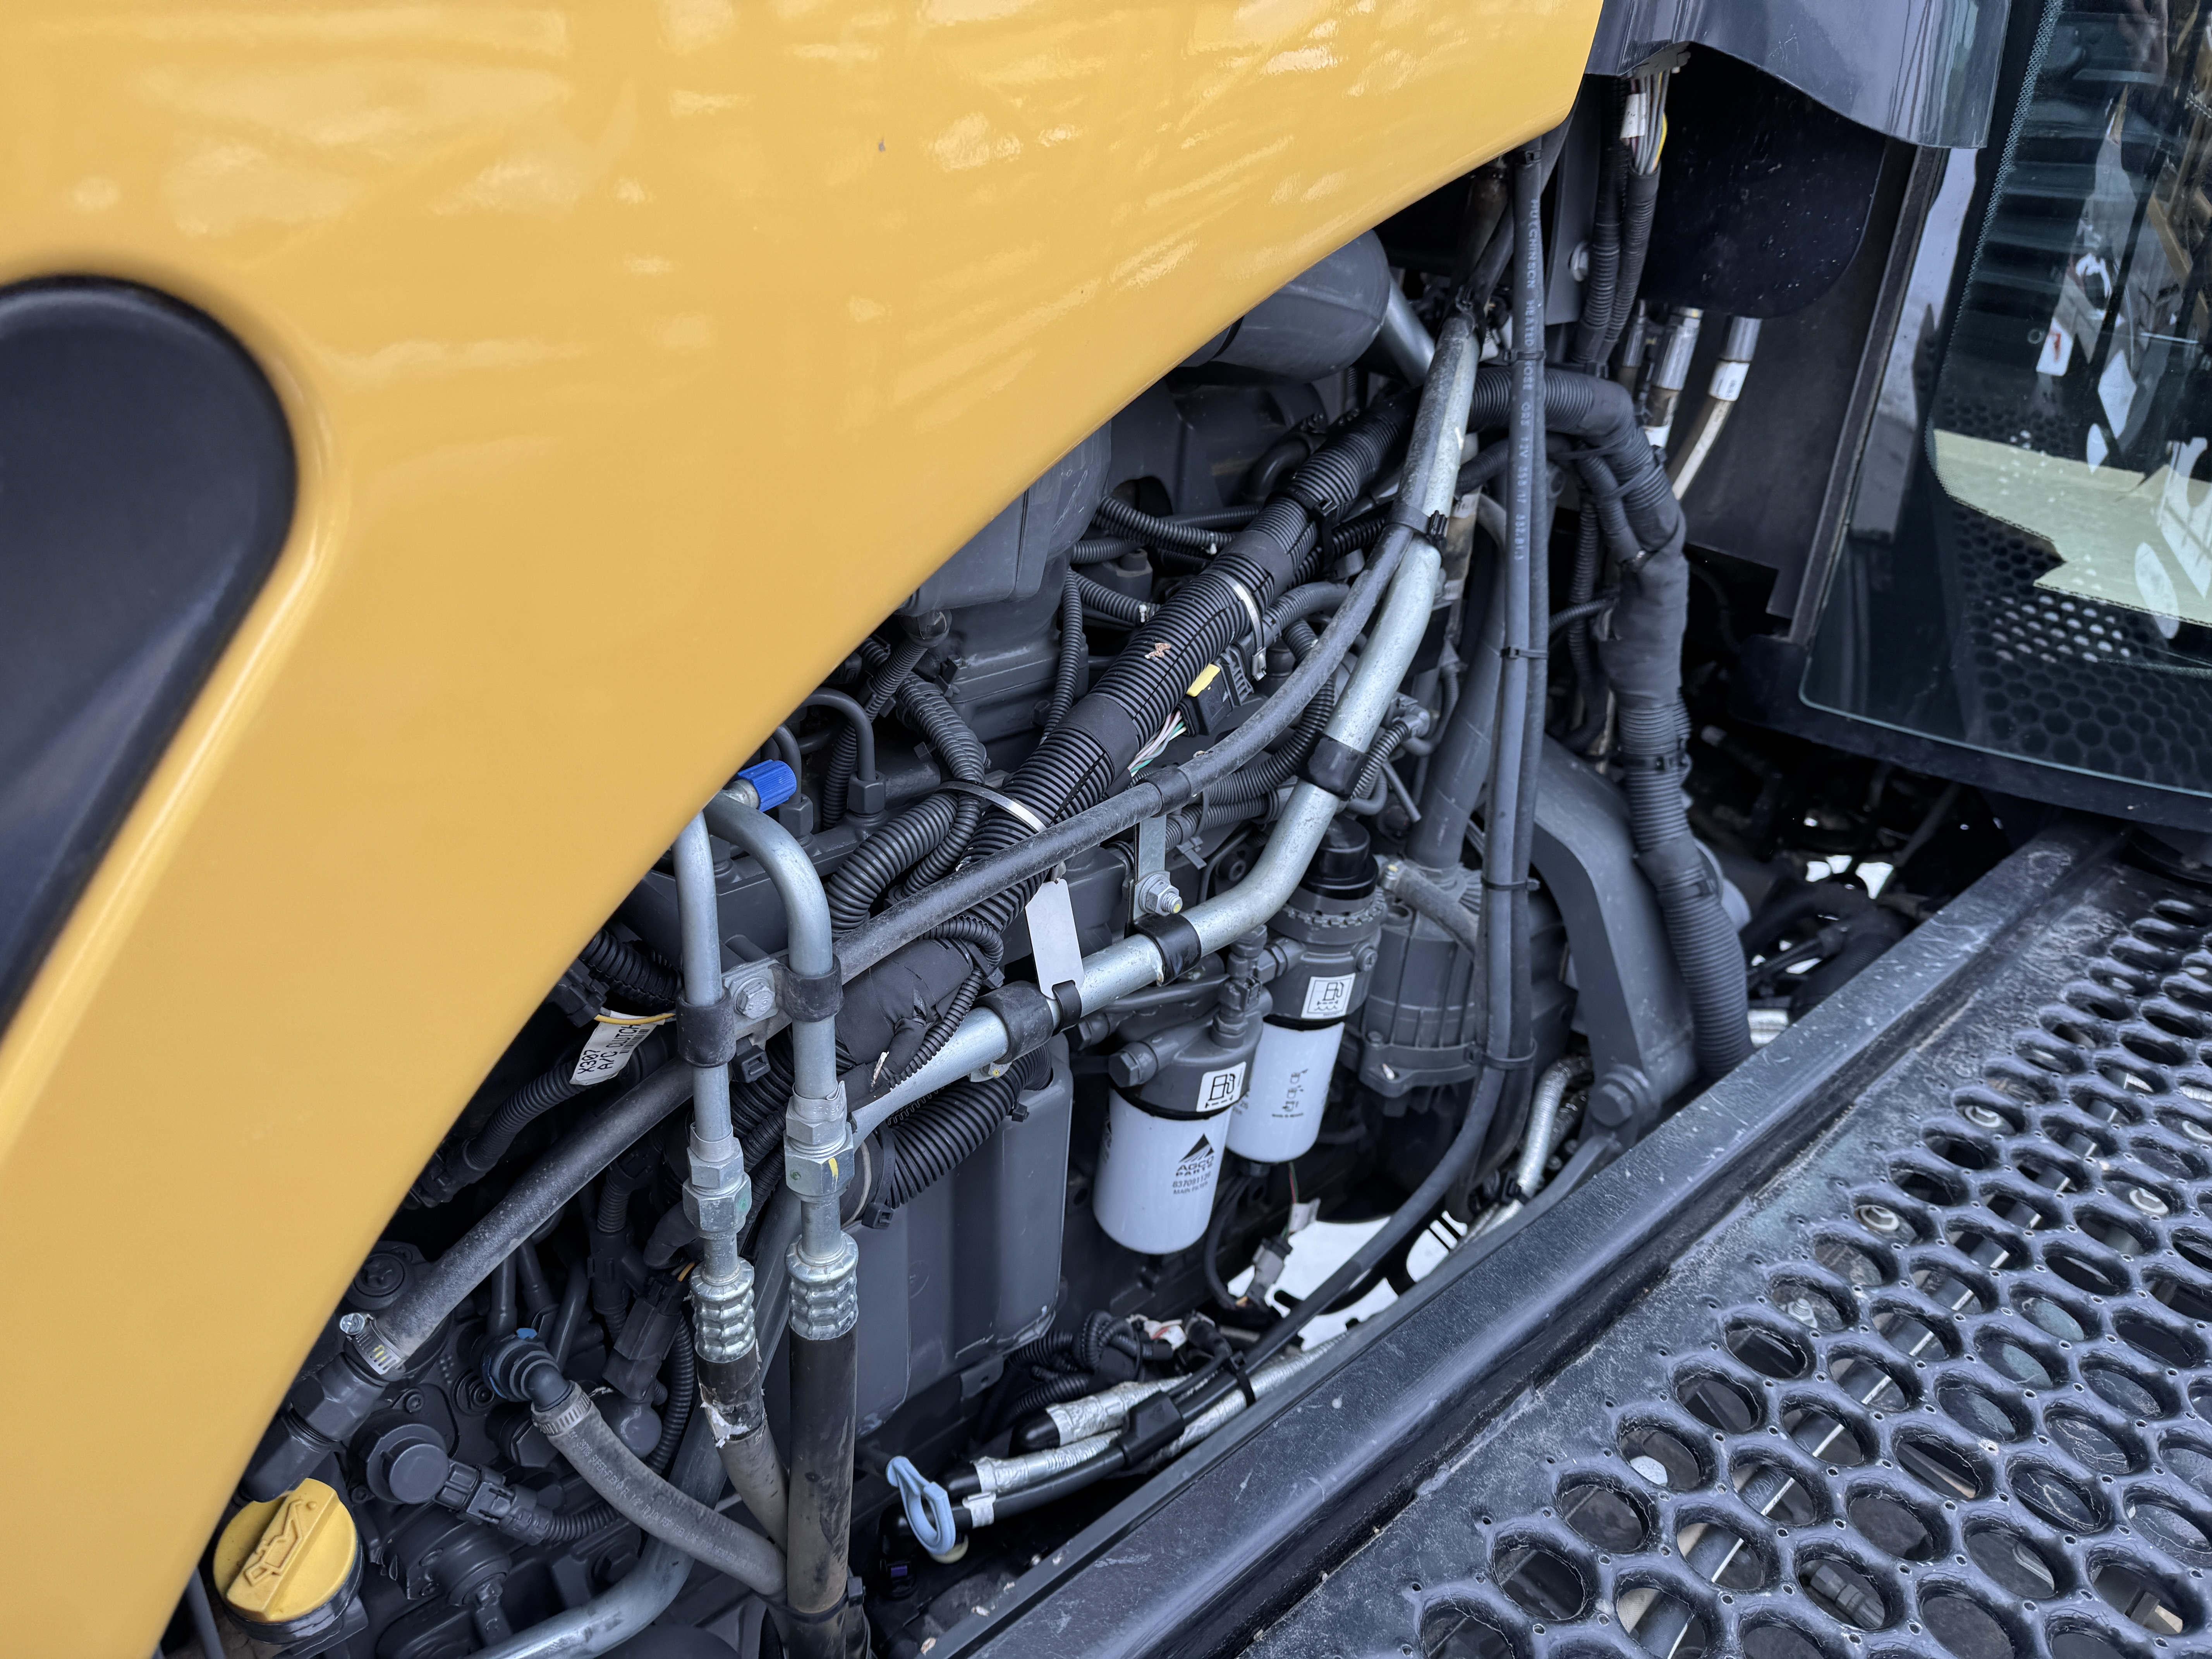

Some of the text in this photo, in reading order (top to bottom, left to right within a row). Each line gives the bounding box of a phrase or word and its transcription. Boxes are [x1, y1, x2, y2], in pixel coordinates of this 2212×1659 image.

[597, 1024, 641, 1070] A/C CLUTCH
[577, 1049, 601, 1074] X307
[1177, 1156, 1214, 1171] AGCO
